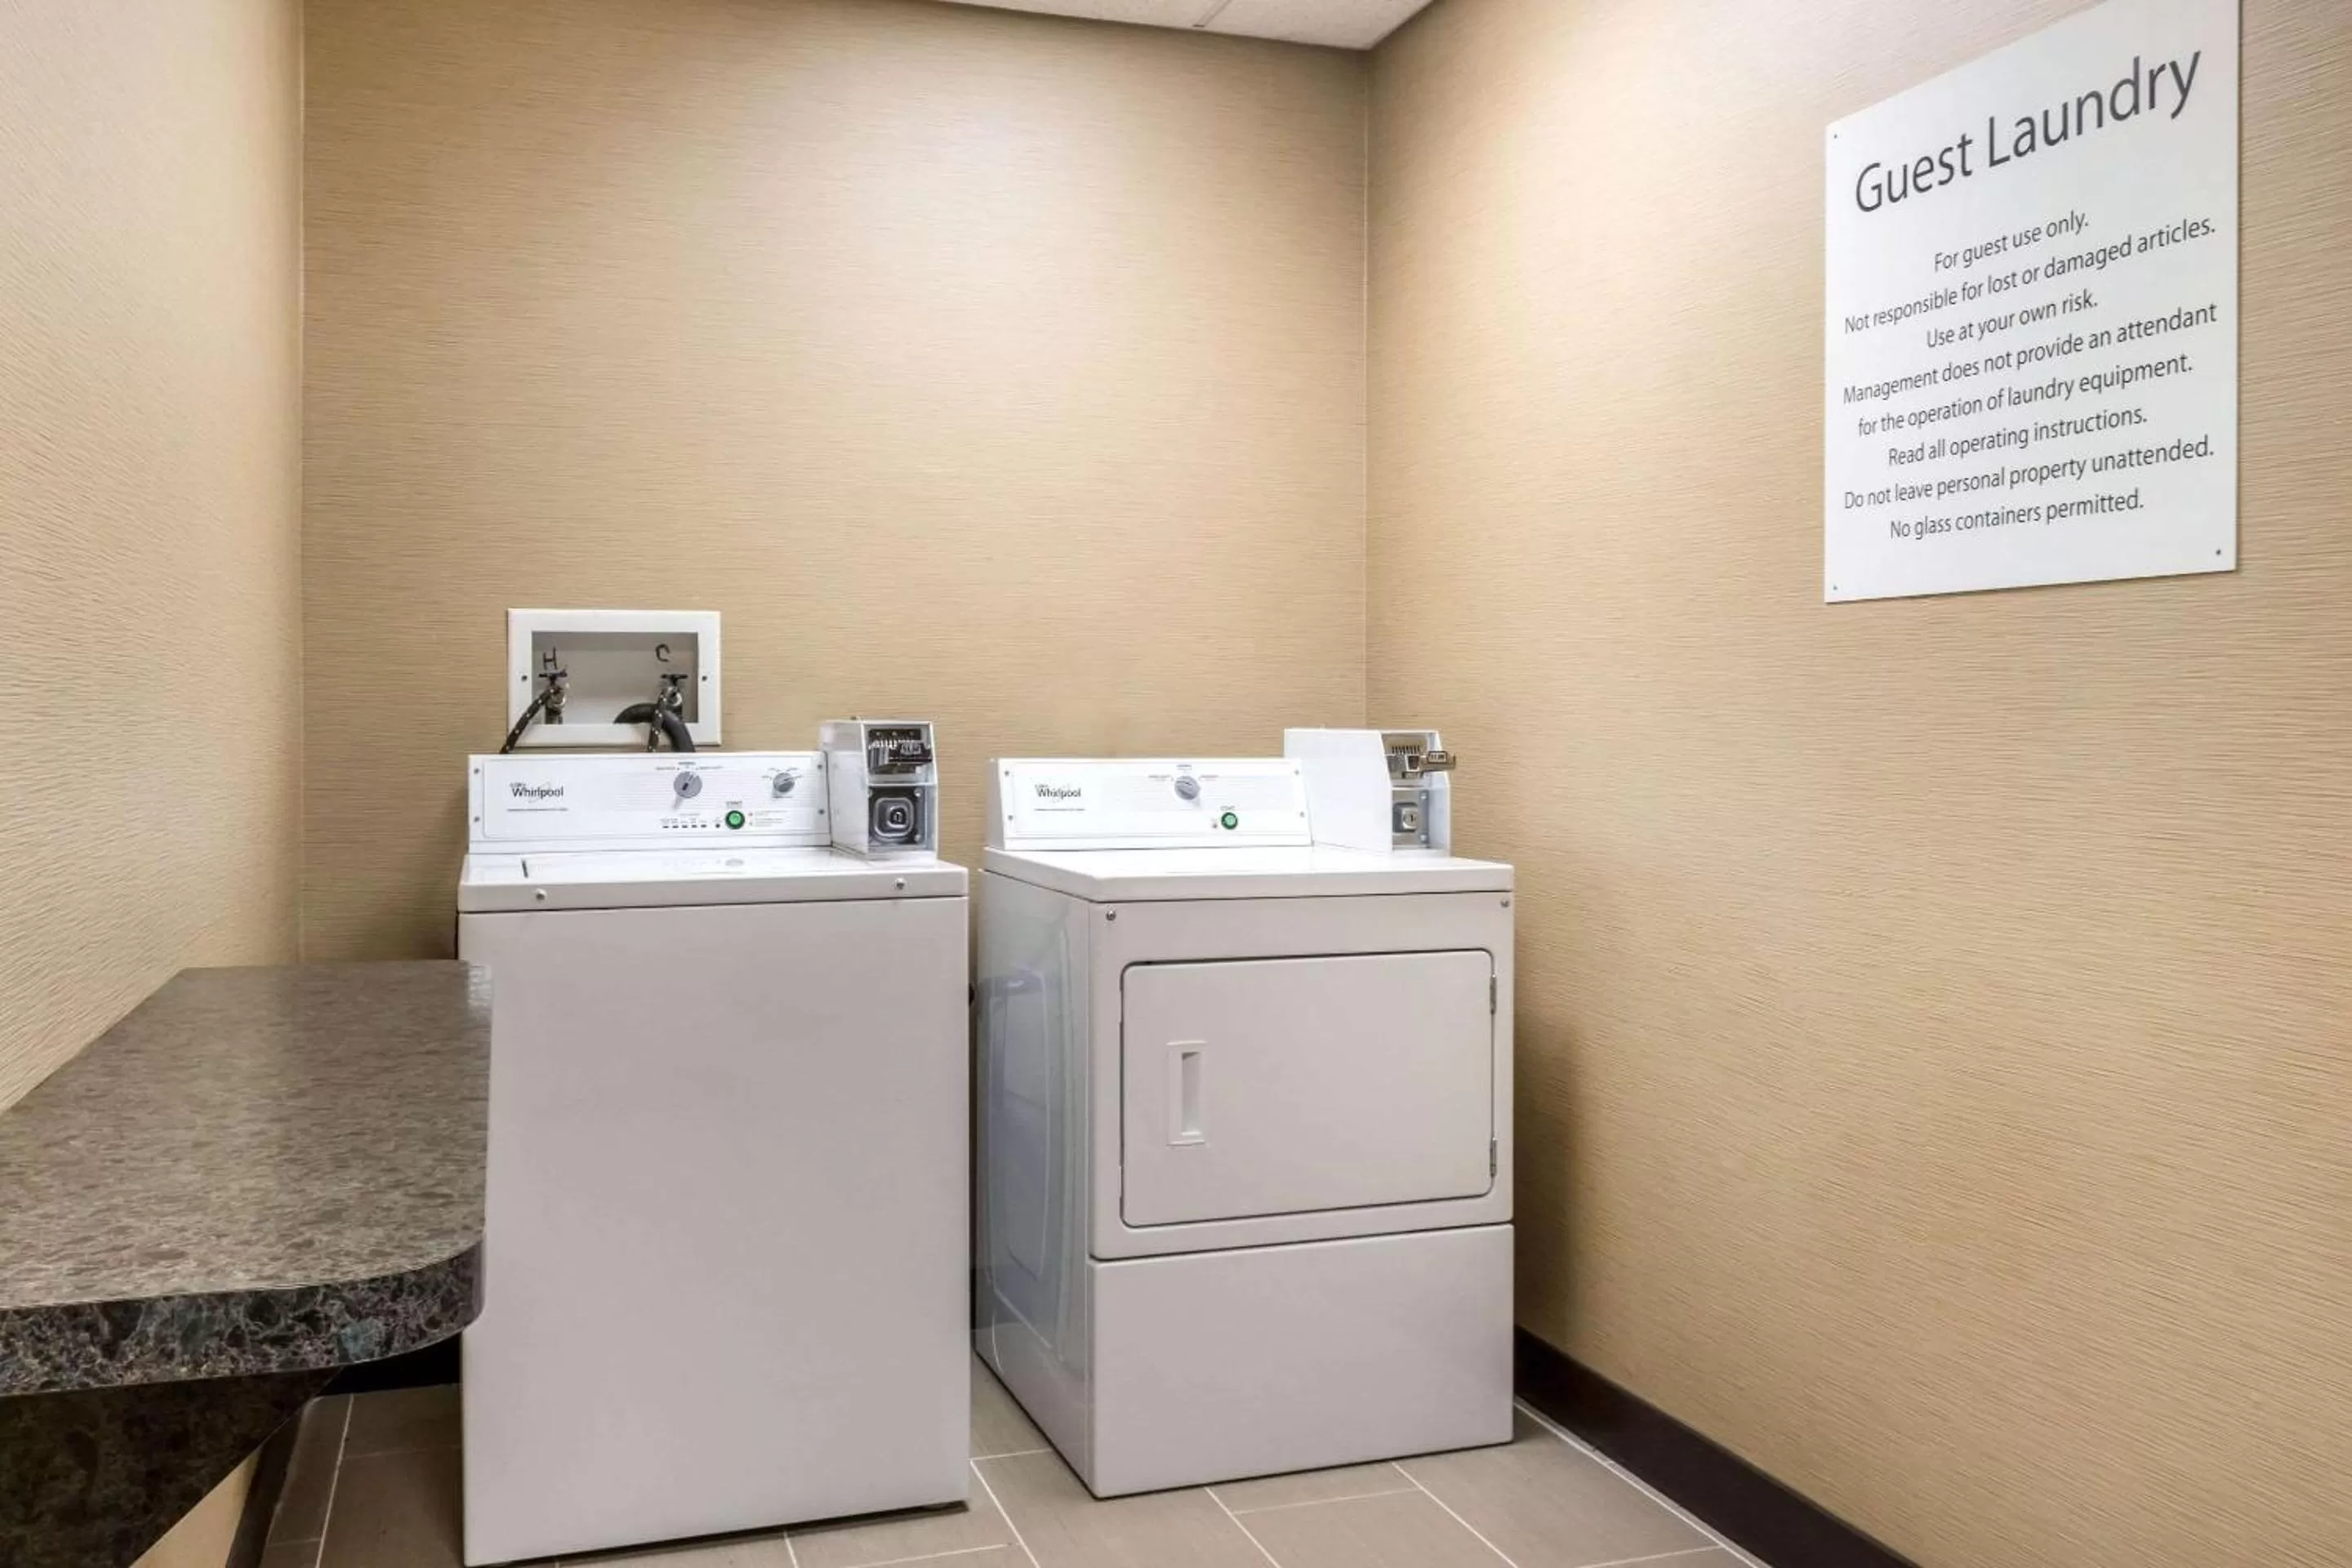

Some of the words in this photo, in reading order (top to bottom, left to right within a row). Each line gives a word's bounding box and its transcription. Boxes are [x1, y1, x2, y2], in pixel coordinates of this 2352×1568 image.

[1855, 132, 1974, 213] Guest
[1988, 50, 2202, 169] Laundry
[1934, 251, 1960, 272] For
[1962, 234, 2008, 269] guest
[2012, 226, 2042, 249] use
[2045, 208, 2089, 238] only.
[1845, 314, 1870, 334] Not
[1873, 287, 1958, 327] responsible
[1961, 281, 1984, 302] for
[1987, 271, 2018, 295] lost
[2021, 266, 2041, 285] or
[2043, 234, 2132, 279] damaged
[2136, 217, 2216, 254] articles.
[1927, 327, 1956, 349] Use
[1958, 322, 1974, 341] at
[1977, 313, 2016, 342] your
[2018, 303, 2057, 326] own
[2061, 287, 2098, 314] risk.
[1843, 368, 1939, 404] Management
[1941, 360, 1980, 382] does
[1984, 350, 2013, 373] not
[2016, 332, 2085, 371] provide
[2087, 330, 2112, 350] an
[2116, 303, 2218, 343] attendant
[1858, 417, 1878, 437] for
[1880, 412, 1905, 432] the
[1907, 398, 1983, 430] operation
[1986, 387, 2005, 411] of
[2007, 376, 2075, 407] laundry
[2078, 353, 2194, 395] equipment.
[1888, 442, 1925, 466] Read
[1927, 438, 1946, 460] all
[1949, 427, 2029, 459] operating
[2034, 408, 2148, 442] instructions.
[1844, 491, 1864, 510] Do
[1867, 488, 1891, 506] not
[1894, 483, 1934, 502] leave
[1936, 466, 2006, 501] personal
[2009, 458, 2087, 490] property
[2091, 434, 2215, 474] unattended.
[1890, 520, 1911, 539] No
[1913, 515, 1952, 541] glass
[1954, 506, 2042, 531] containers
[2046, 487, 2145, 526] permitted.
[542, 646, 558, 670] H
[655, 643, 670, 662] C
[511, 786, 564, 800] Whirlpool
[1036, 787, 1081, 800] Whirlpool
